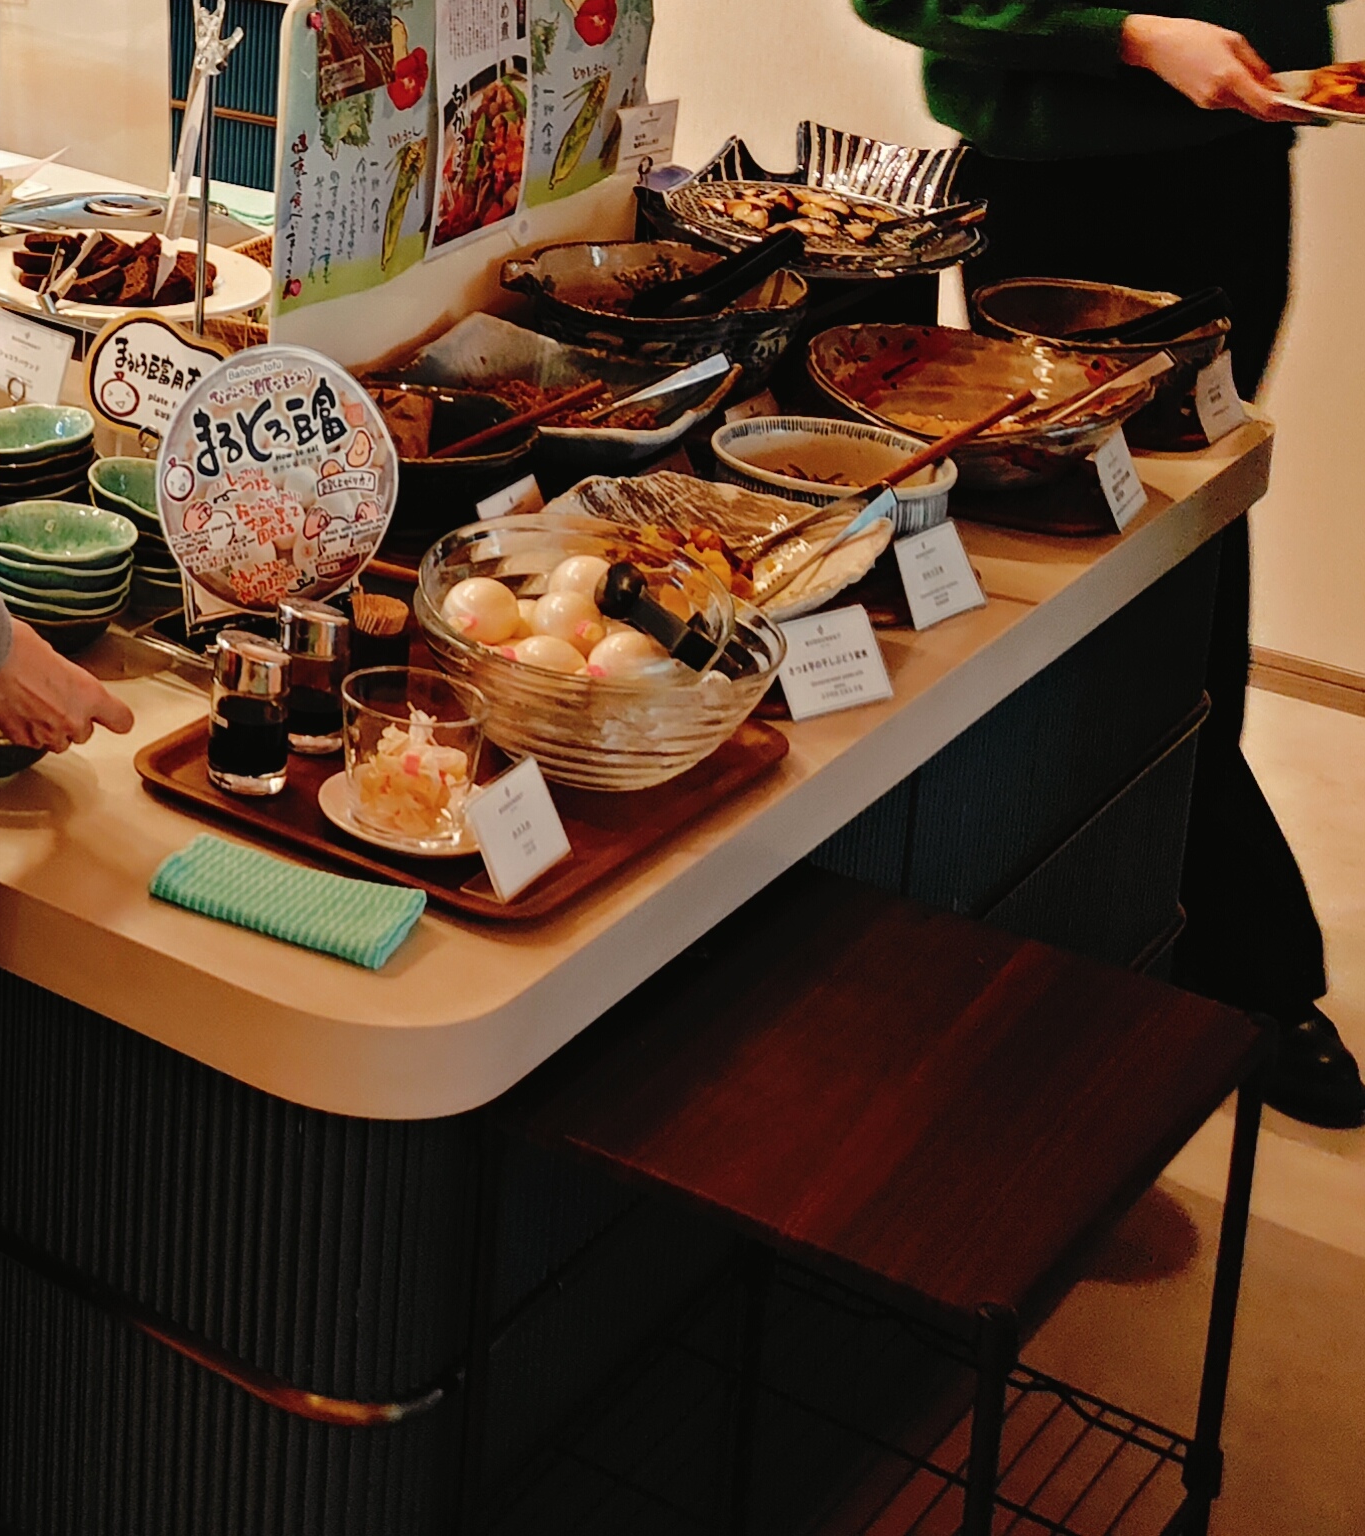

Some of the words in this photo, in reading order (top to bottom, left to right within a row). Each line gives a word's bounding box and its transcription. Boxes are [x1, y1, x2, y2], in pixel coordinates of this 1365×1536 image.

[227, 364, 261, 381] Balloon
[263, 360, 284, 374] tofu
[147, 393, 169, 407] plate
[194, 377, 348, 477] まるとろ豆富
[275, 452, 294, 462] How
[295, 449, 305, 457] to
[306, 446, 319, 455] eat
